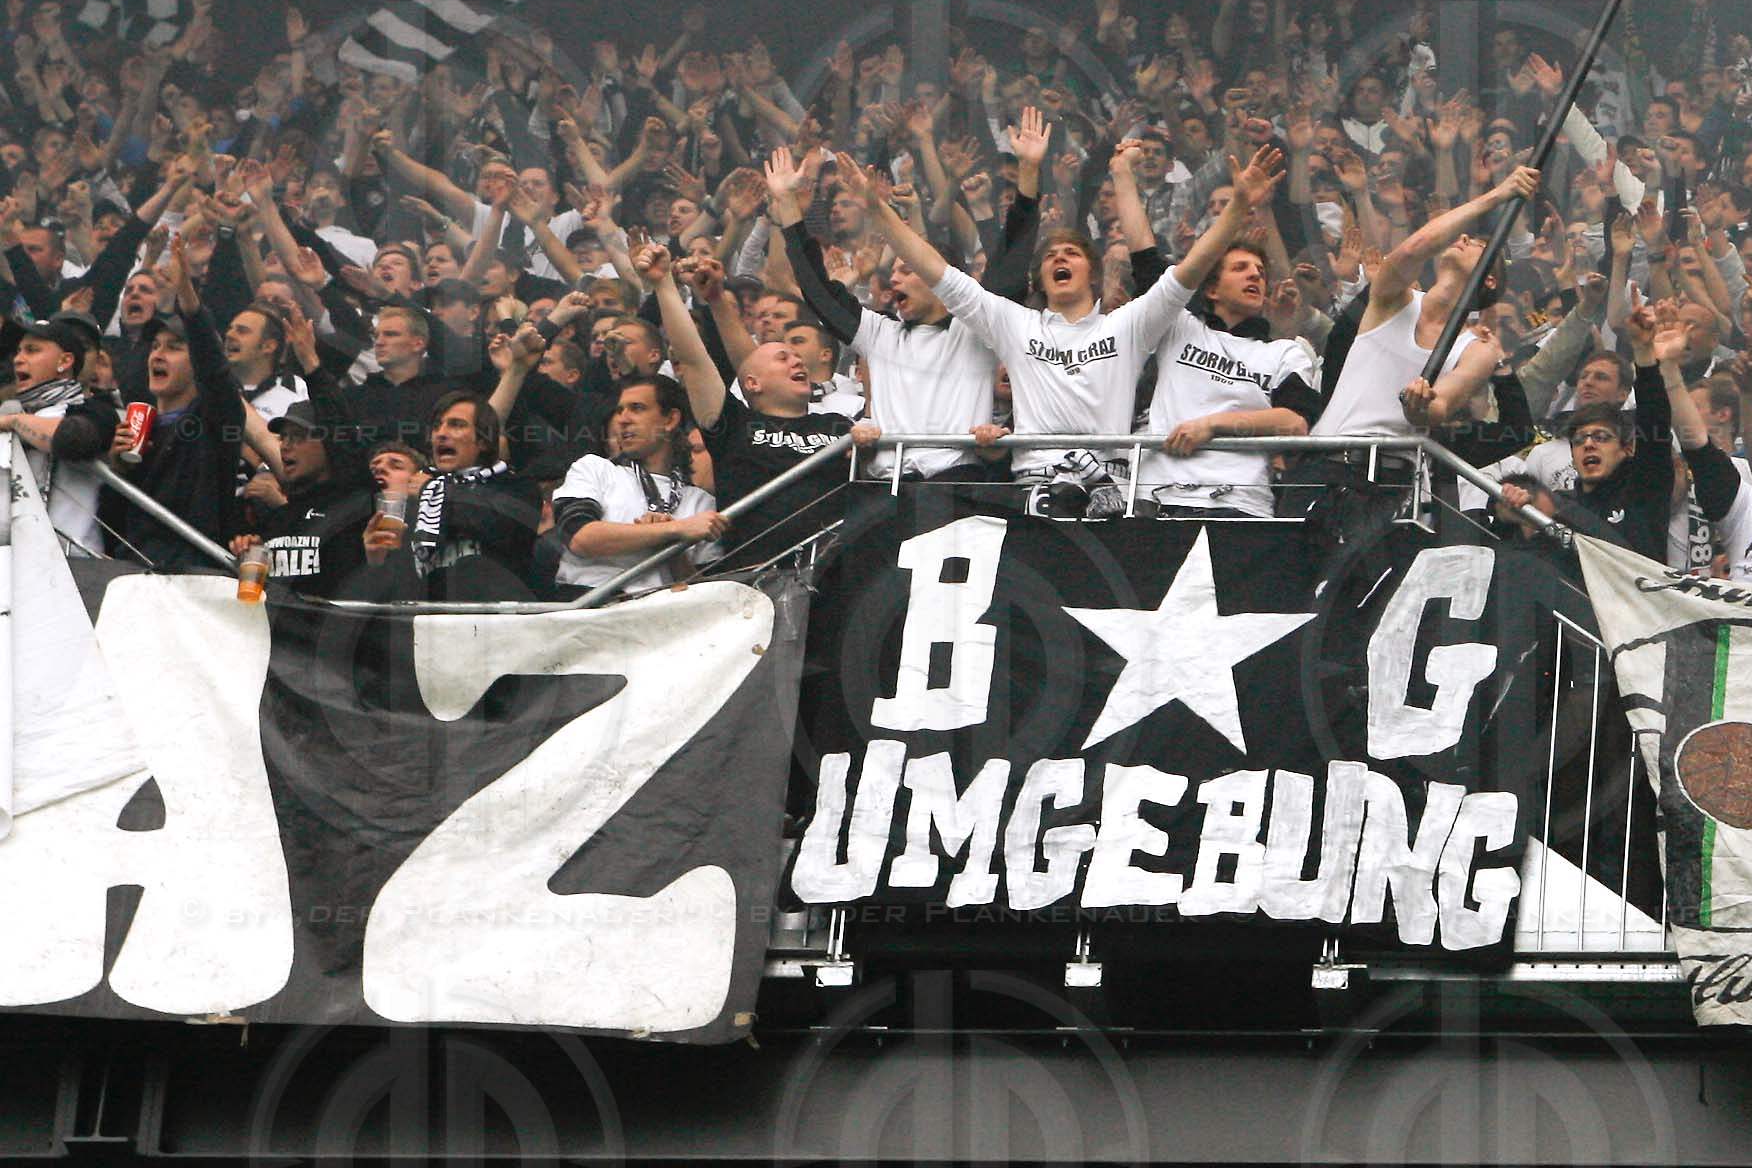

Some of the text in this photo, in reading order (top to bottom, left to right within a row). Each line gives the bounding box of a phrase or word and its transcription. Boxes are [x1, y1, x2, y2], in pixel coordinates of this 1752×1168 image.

[1077, 336, 1117, 363] GRAZ
[870, 514, 1498, 760] B G
[791, 738, 1521, 951] UMGEBUNG
